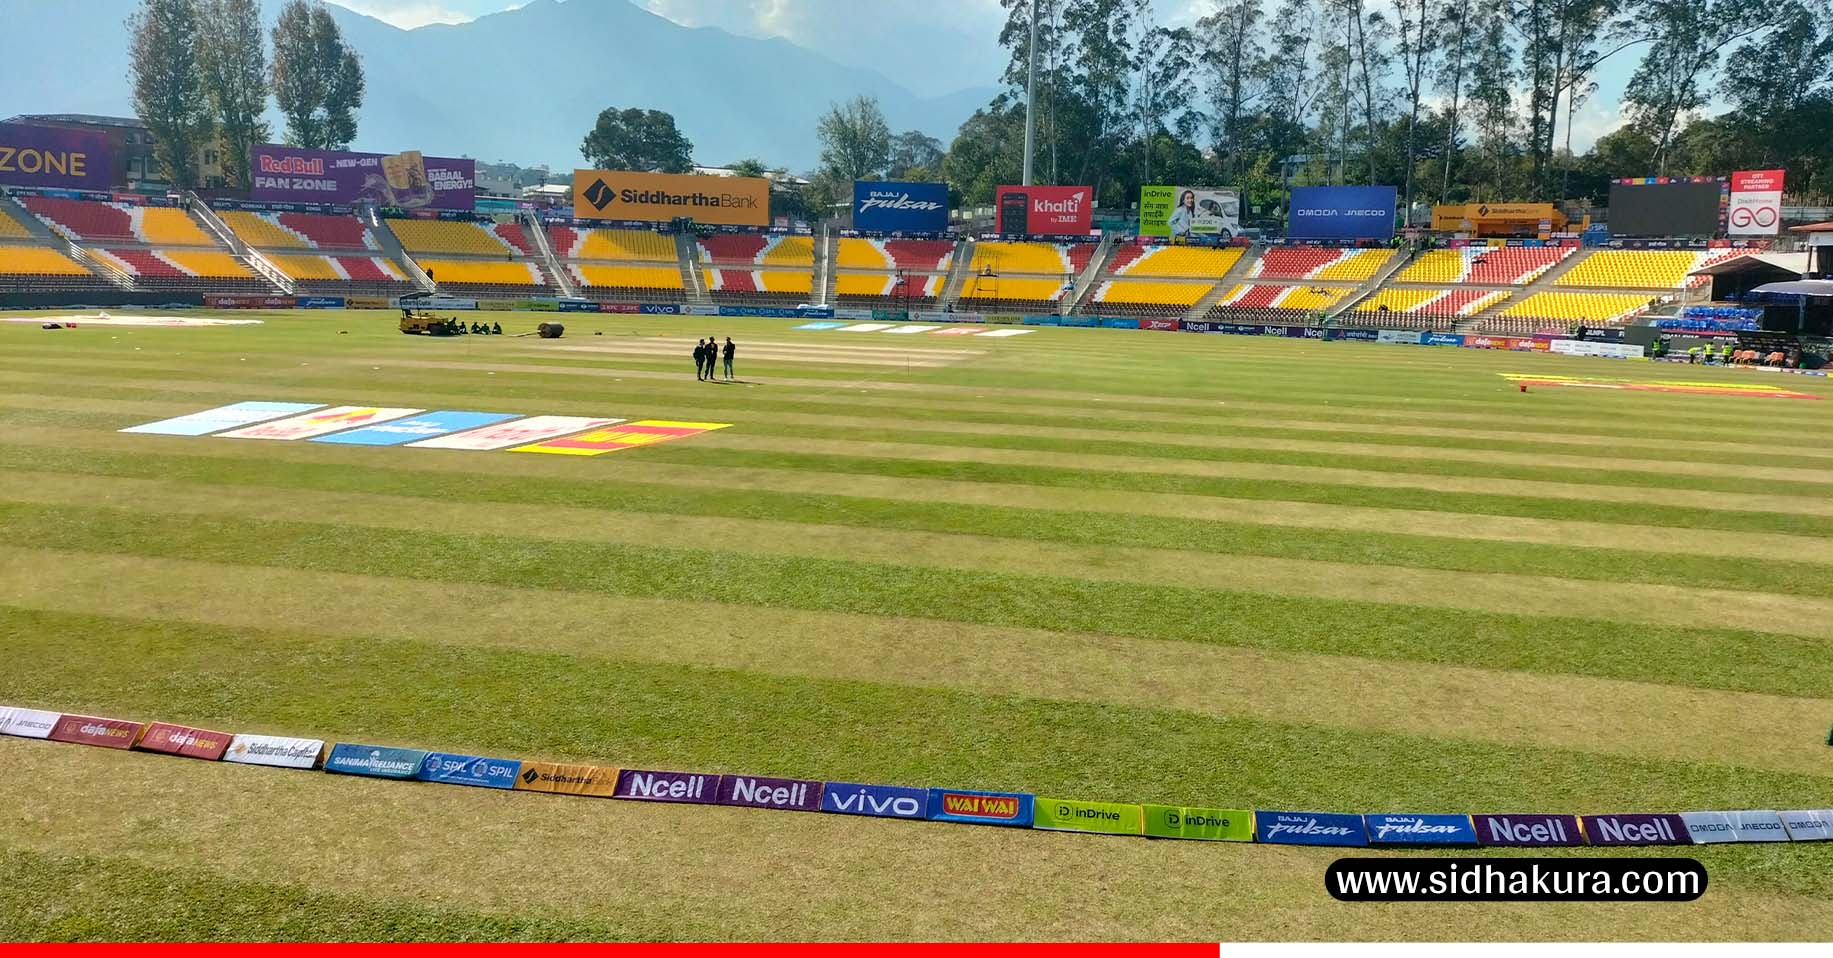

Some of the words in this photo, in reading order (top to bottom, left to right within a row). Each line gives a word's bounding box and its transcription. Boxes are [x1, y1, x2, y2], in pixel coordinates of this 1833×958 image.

[0, 148, 87, 177] ZONE
[260, 155, 292, 173] Red
[293, 157, 324, 175] Bull
[255, 177, 290, 190] FAN
[292, 179, 336, 191] ZONE
[428, 171, 464, 182] BABAAL
[860, 193, 943, 213] pulsar
[1034, 199, 1078, 213] khalti
[646, 304, 674, 313] vivo
[1186, 322, 1210, 331] Ncell
[1264, 326, 1288, 335] Ncell
[247, 743, 287, 758] Siddhartha
[442, 760, 467, 773] SPIL
[488, 766, 513, 779] SPIL
[629, 773, 704, 799] Ncell
[732, 777, 807, 806] Ncell
[832, 789, 920, 815] vivo
[946, 796, 979, 813] WAI
[981, 799, 1015, 815] WAI
[1075, 807, 1120, 822] inDrive
[1185, 815, 1231, 828] inDrive
[1277, 815, 1308, 823] BAJAJ
[1266, 818, 1356, 840] pulsar
[1375, 818, 1463, 840] pulsar
[1487, 816, 1568, 842] Ncell
[1596, 817, 1677, 842] Ncell
